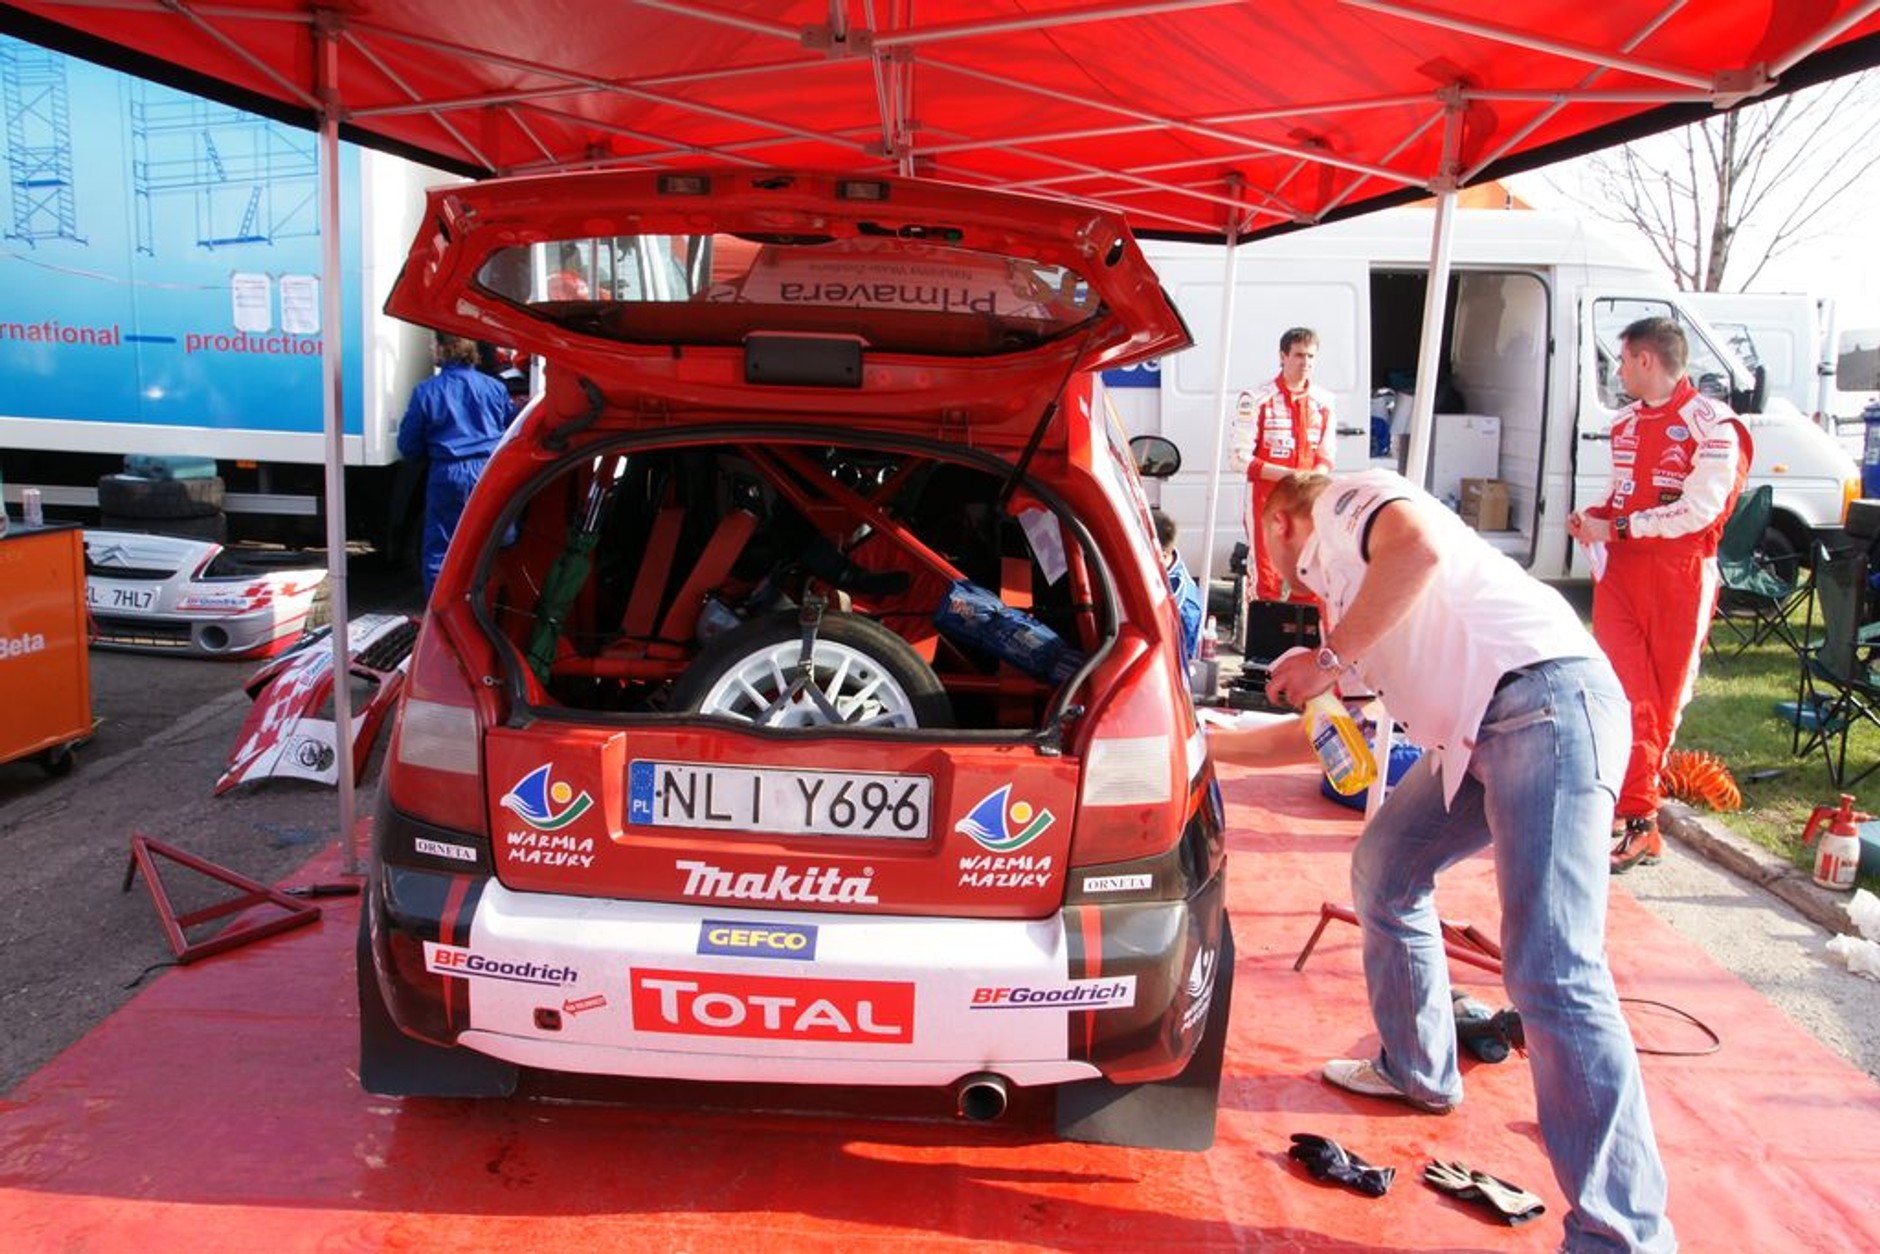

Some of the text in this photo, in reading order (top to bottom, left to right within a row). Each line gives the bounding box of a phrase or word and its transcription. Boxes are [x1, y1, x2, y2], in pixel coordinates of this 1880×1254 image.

[779, 282, 998, 314] Primavera
[112, 589, 152, 608] 7HL7
[633, 799, 650, 813] PL
[797, 778, 919, 831] Y696
[418, 839, 472, 860] ORNETA
[507, 831, 593, 852] WARMIA
[508, 847, 595, 868] MAZURY
[959, 855, 1052, 871] WARMIA
[957, 872, 1052, 888] MAZURY
[1088, 877, 1146, 890] ORNETA
[708, 927, 807, 950] GEFCO
[434, 948, 578, 983] BFGoodrich
[971, 982, 1128, 1004] BFGoodrich
[641, 977, 902, 1035] TOTAL
